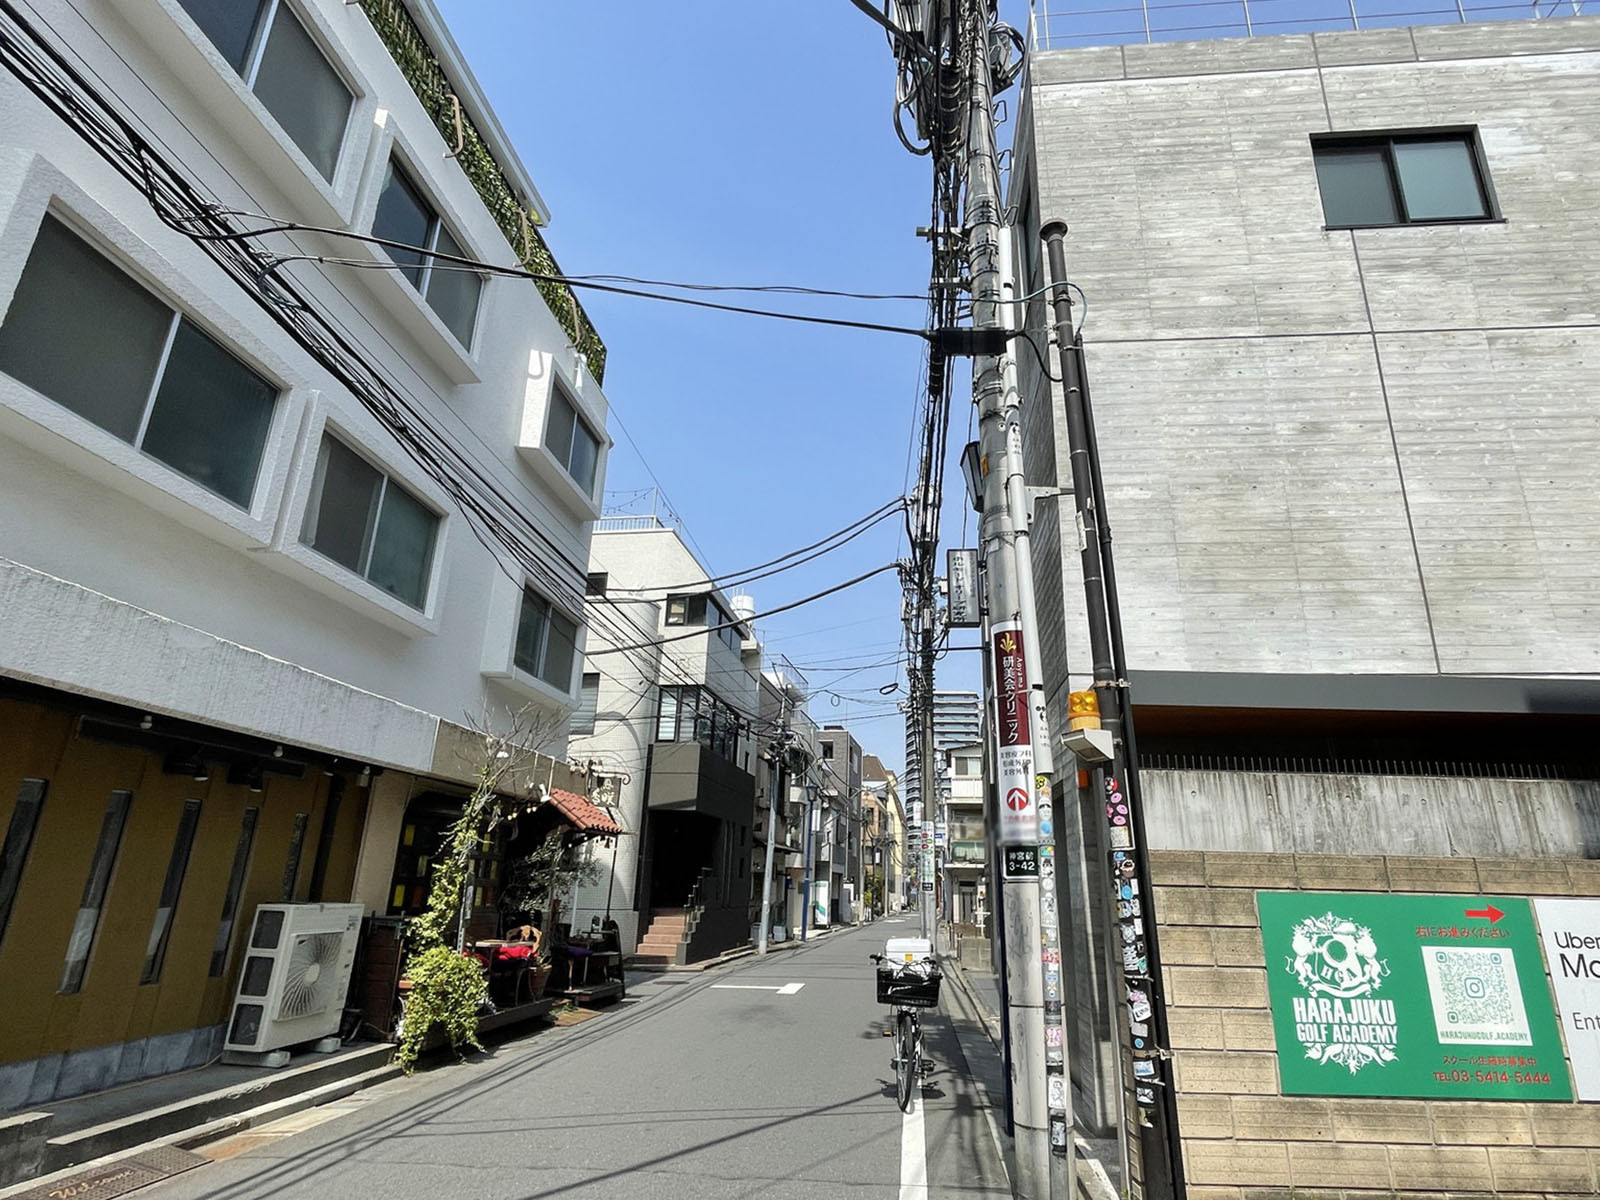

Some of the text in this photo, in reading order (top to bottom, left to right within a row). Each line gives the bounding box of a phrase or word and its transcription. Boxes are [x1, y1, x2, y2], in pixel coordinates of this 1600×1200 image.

[1002, 656, 1019, 744] 研美会クリニック
[1008, 861, 1035, 871] 3-42
[1415, 926, 1510, 938] 右にお進みください
[1292, 997, 1396, 1025] HARAJUKU
[1296, 1023, 1398, 1044] GOLF ACADEMY
